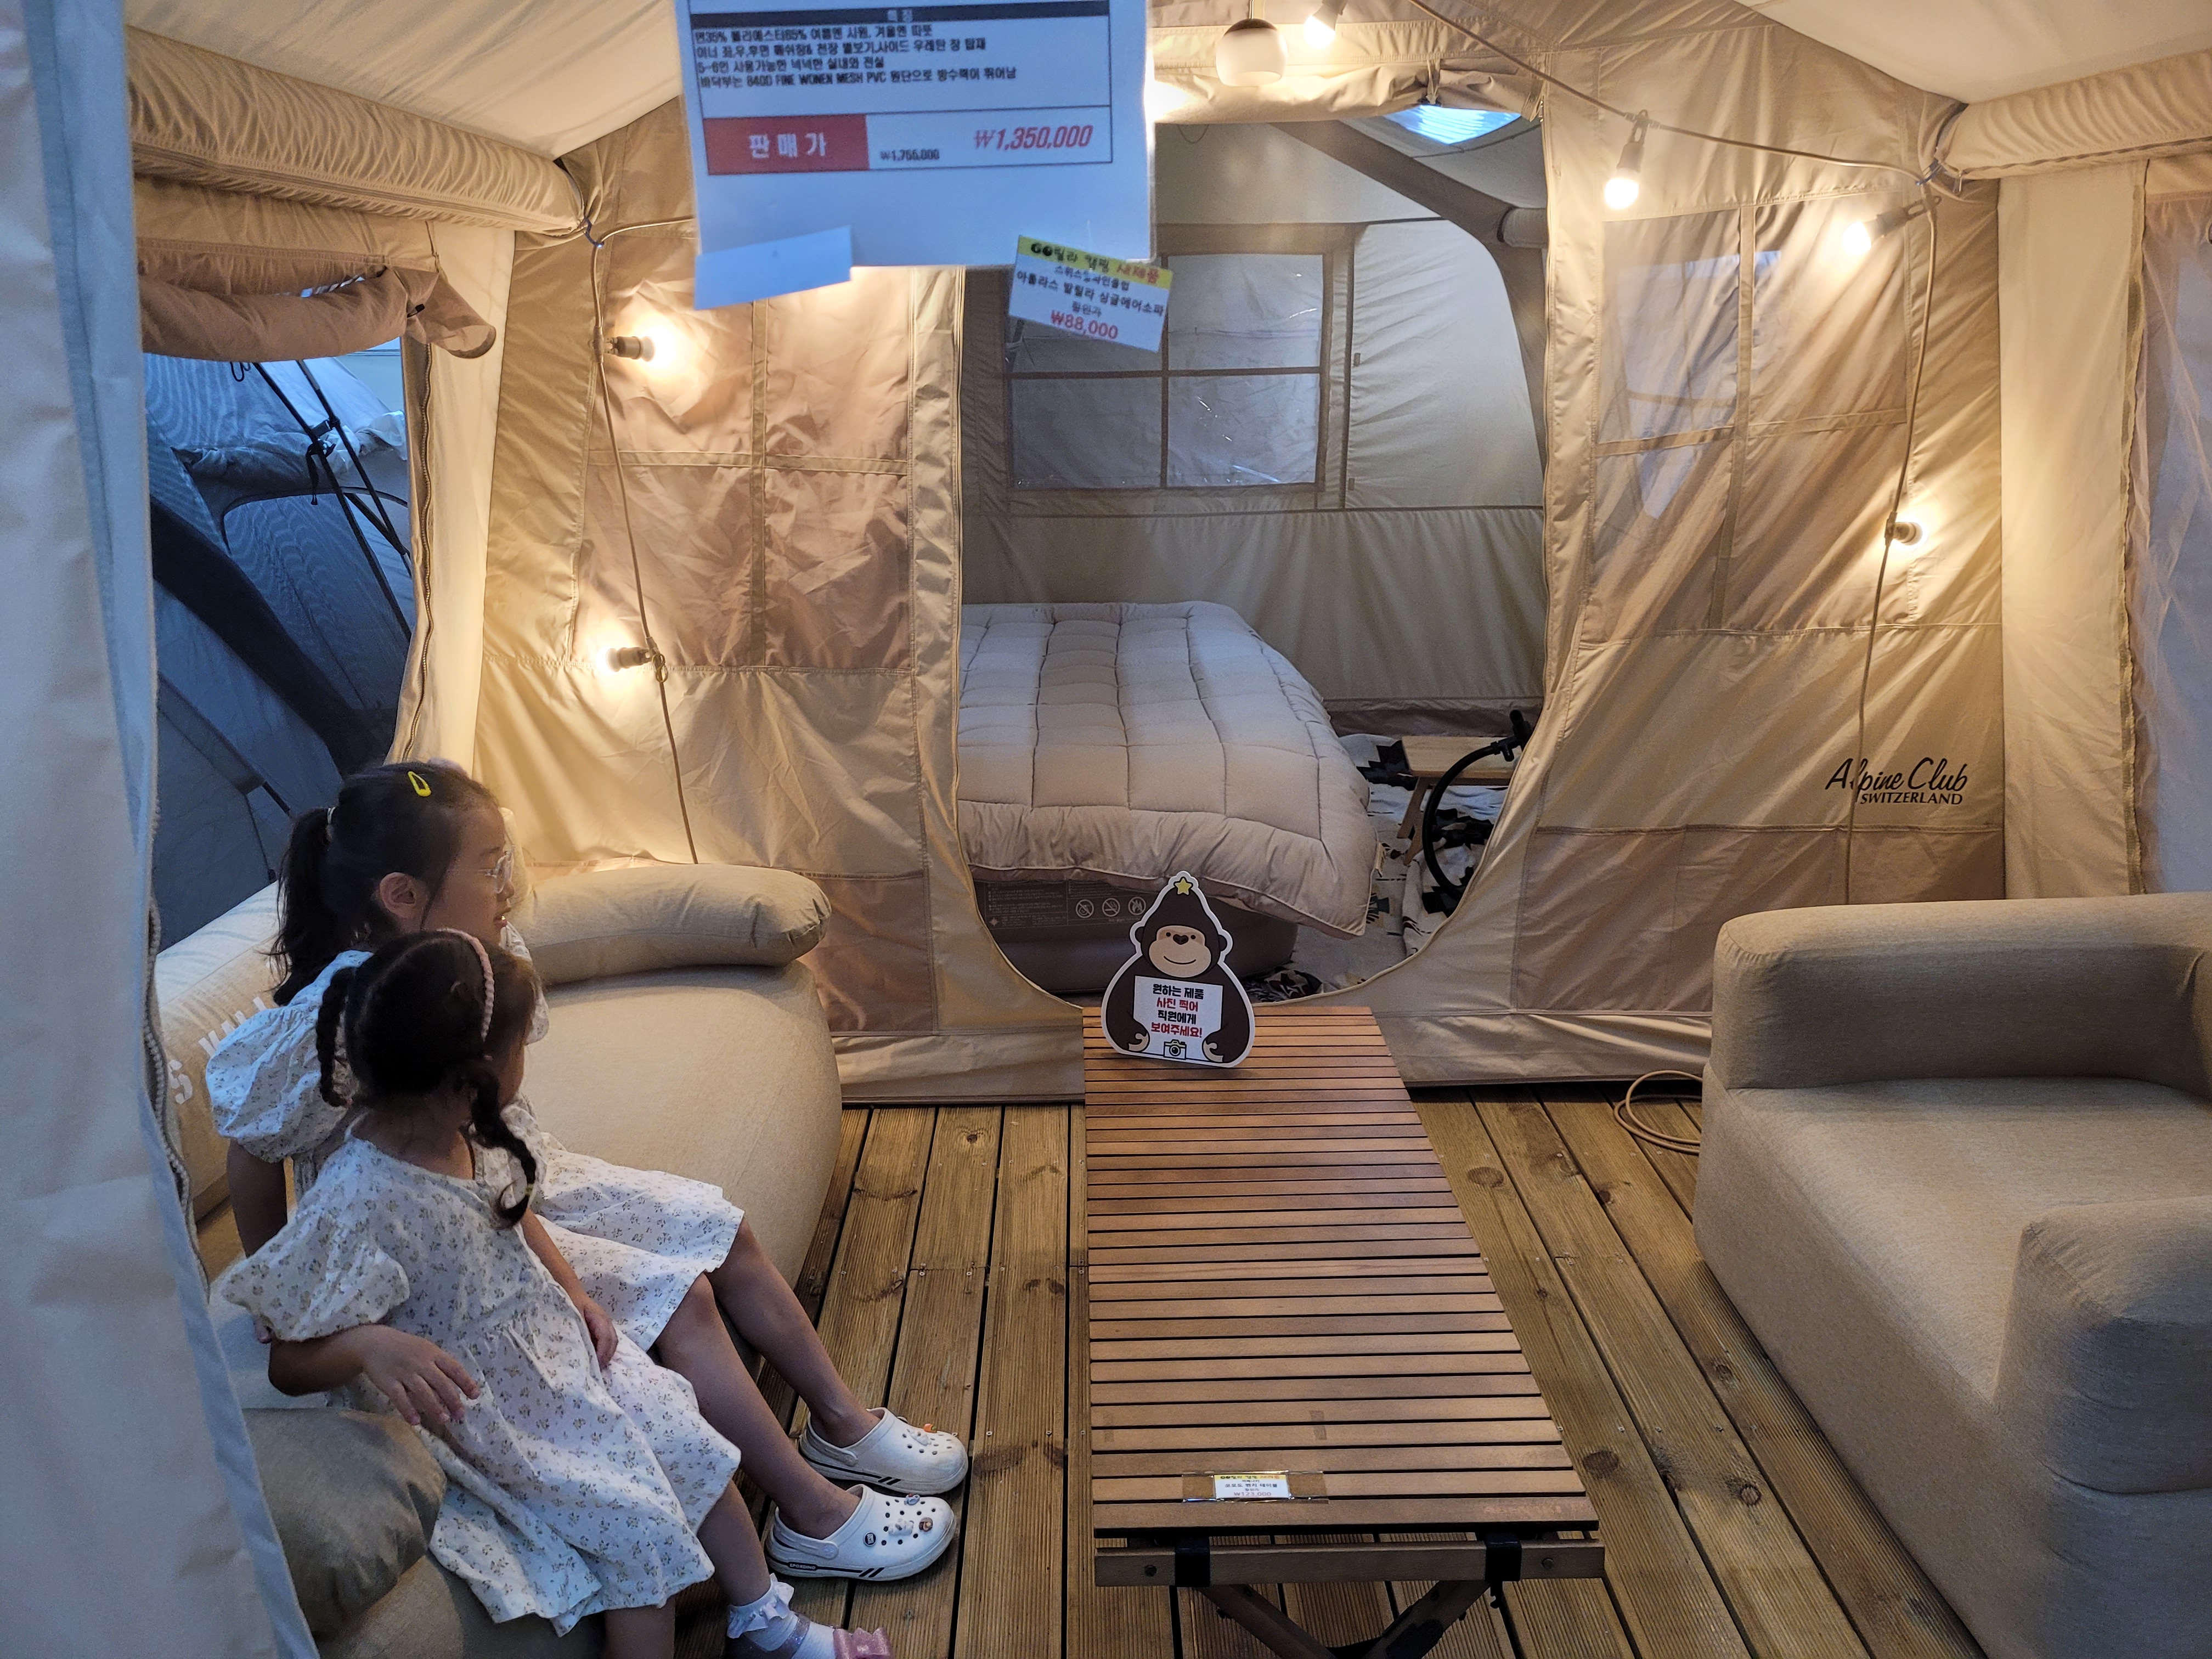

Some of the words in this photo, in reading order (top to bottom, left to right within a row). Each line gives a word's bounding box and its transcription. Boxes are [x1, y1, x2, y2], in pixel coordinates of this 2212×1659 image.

[866, 70, 887, 83] PVC
[1051, 309, 1119, 340] ₩88,000
[1825, 758, 1905, 803] Alpine
[1908, 757, 1968, 792] Club
[1860, 792, 1963, 805] SWITZERLAND
[1153, 984, 1182, 997] 원하는
[1184, 988, 1204, 1000] 제품
[1156, 997, 1176, 1009] 사진
[1179, 999, 1198, 1012] 찍어
[1158, 1009, 1197, 1025] 직원에게
[1151, 1022, 1203, 1039] 보여주세요!
